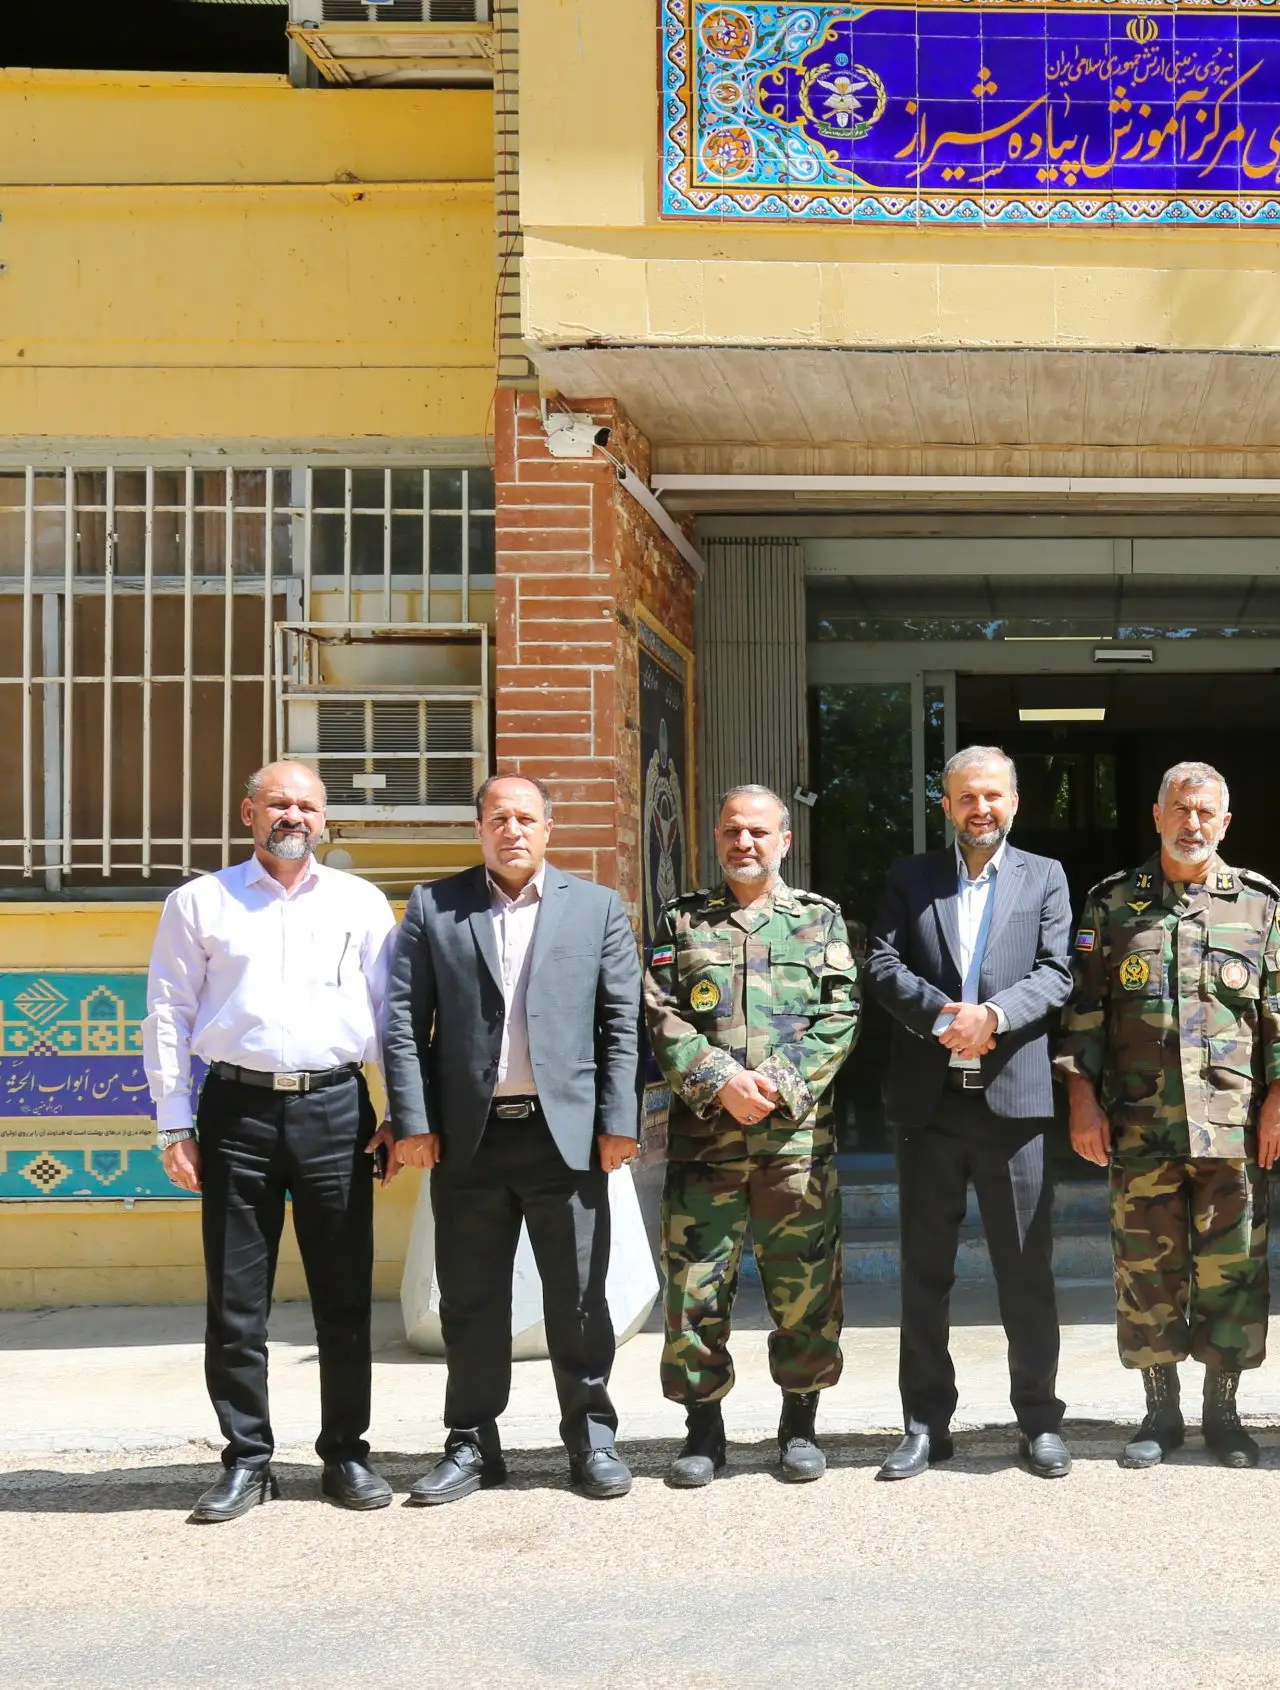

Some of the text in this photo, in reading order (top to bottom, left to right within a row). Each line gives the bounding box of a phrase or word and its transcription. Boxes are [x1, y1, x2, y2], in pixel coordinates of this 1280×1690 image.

[1045, 44, 1078, 87] ایران
[1067, 43, 1109, 82] اسلامی
[1099, 52, 1142, 87] جمهوری
[1133, 45, 1165, 83] ارتش
[1164, 50, 1198, 85] زمینی
[894, 66, 1051, 183] شیراز
[1080, 85, 1209, 179] آموزش
[1187, 58, 1265, 178] مرکز
[1008, 92, 1083, 187] پیاده
[72, 1128, 86, 1136] است
[87, 1128, 103, 1137] بهشت
[139, 1128, 152, 1136] جهاد
